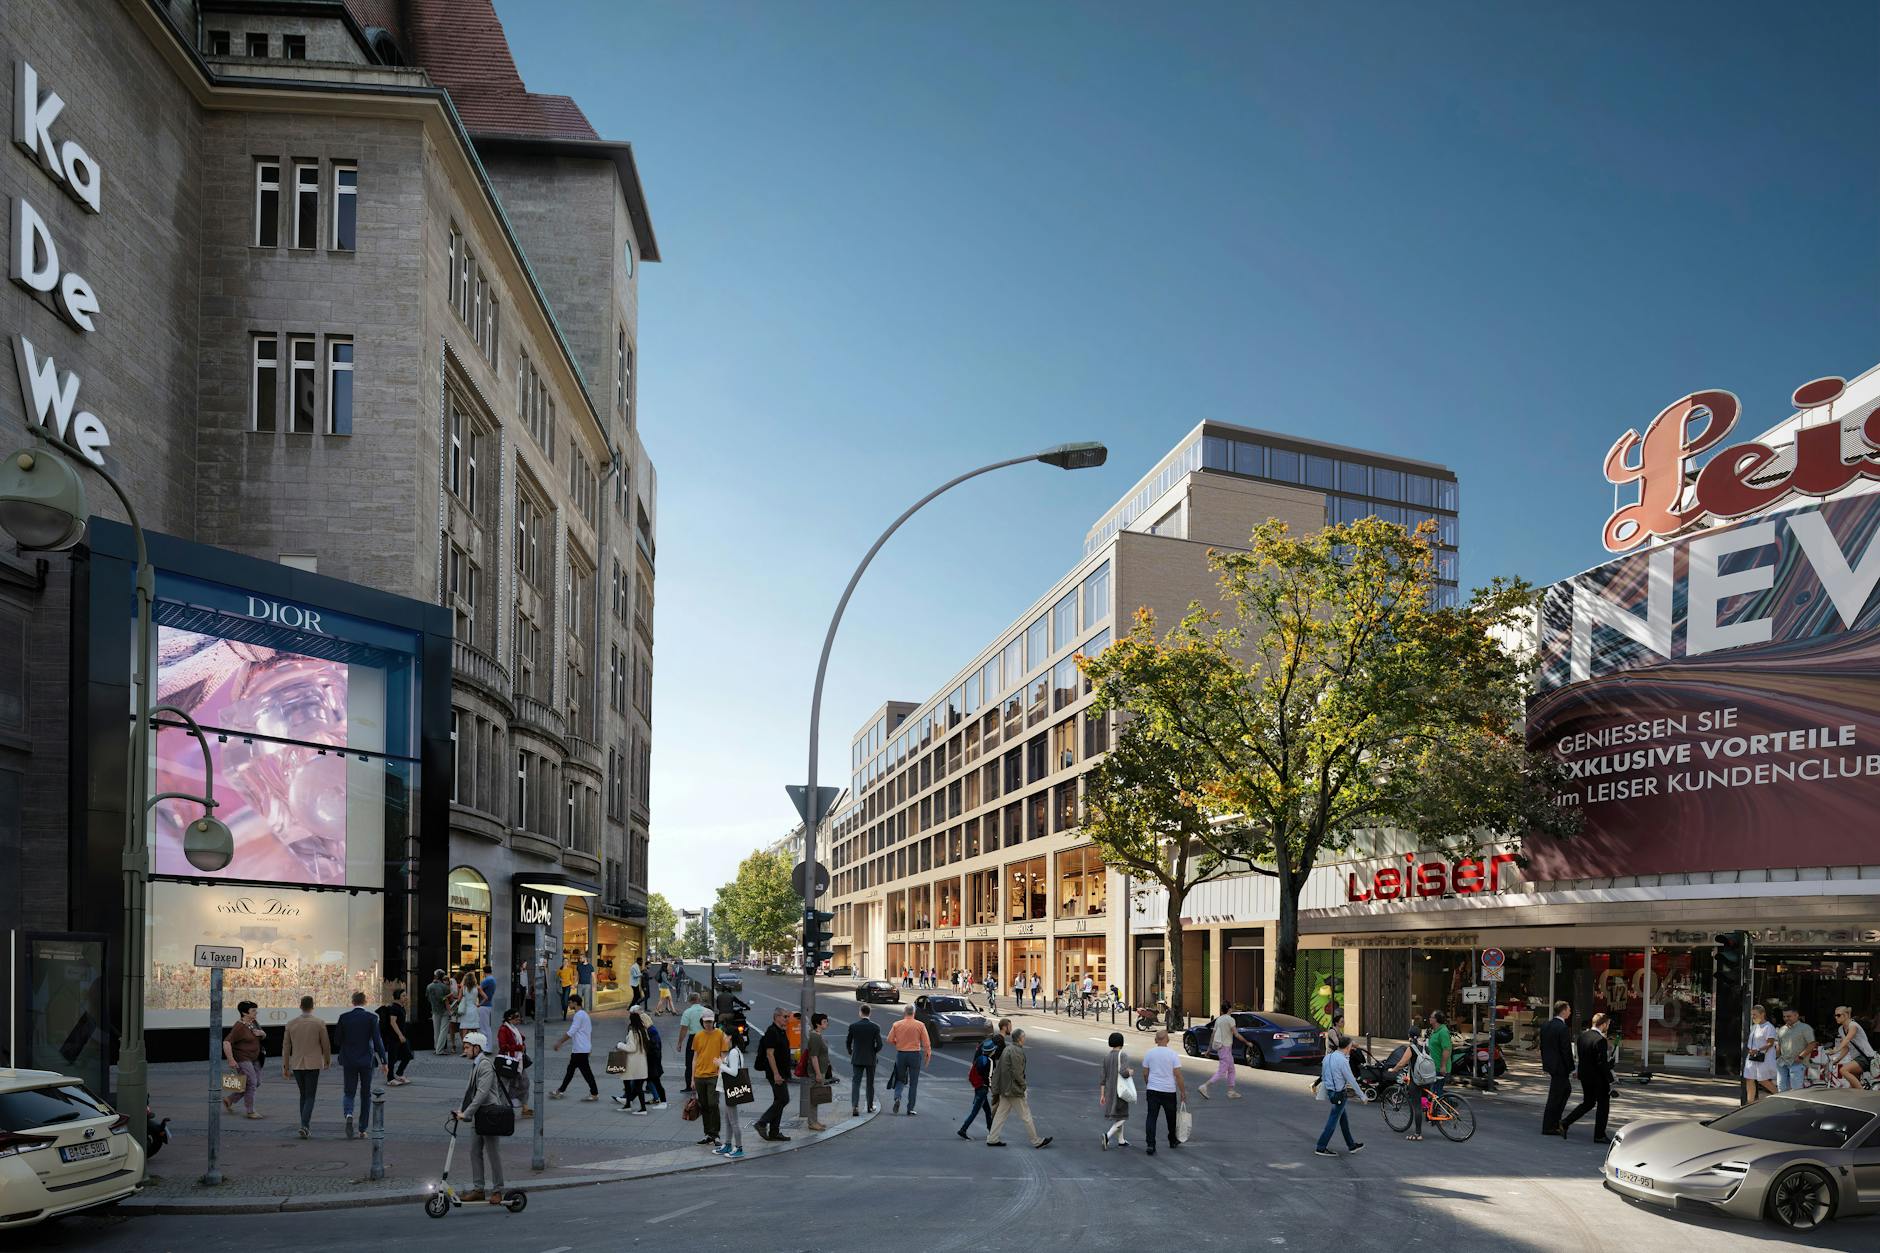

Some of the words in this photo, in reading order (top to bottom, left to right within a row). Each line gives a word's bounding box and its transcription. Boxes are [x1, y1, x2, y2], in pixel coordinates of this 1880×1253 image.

[16, 60, 101, 215] Ka
[14, 199, 101, 333] De
[16, 334, 111, 467] We
[1602, 376, 1880, 553] Lei
[247, 595, 324, 634] DIOR
[1557, 715, 1688, 755] GENIESSEN
[1697, 707, 1738, 732] SIE
[1700, 724, 1857, 760] VORTEILE
[1556, 789, 1580, 807] im
[1586, 777, 1659, 804] LEISER
[1668, 754, 1880, 793] KUNDENCLUB
[1349, 852, 1522, 902] Leiser
[262, 899, 300, 916] Dior
[520, 894, 552, 926] KaDeWe
[1651, 926, 1880, 944] intertionale
[201, 951, 207, 960] 4
[210, 952, 237, 963] Taxen
[245, 957, 288, 969] DIOR
